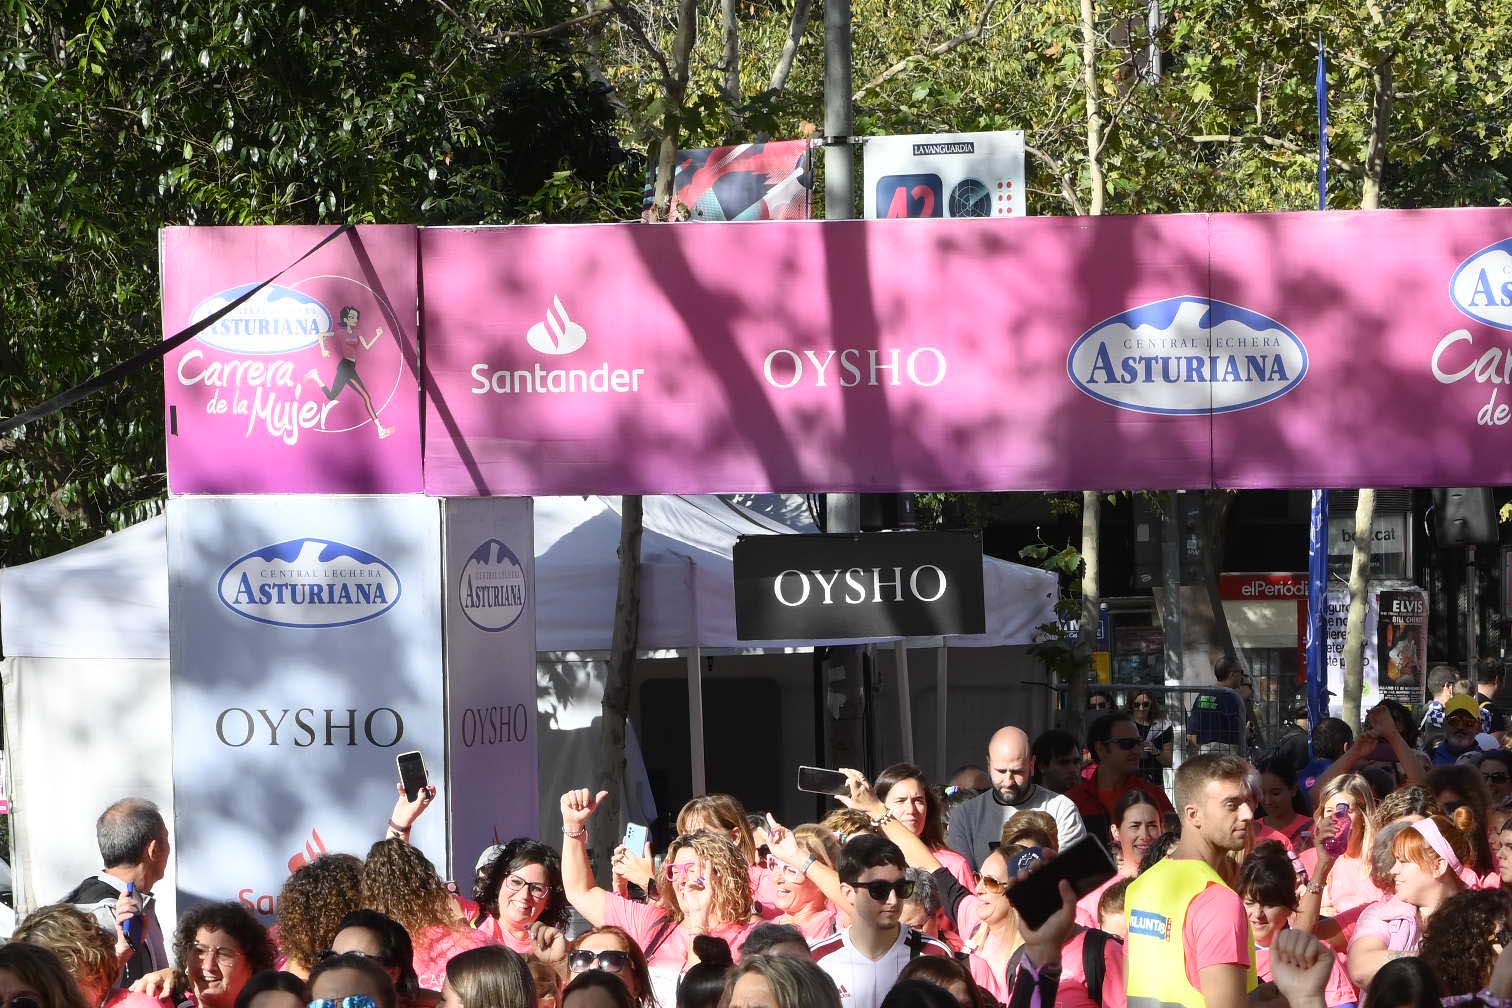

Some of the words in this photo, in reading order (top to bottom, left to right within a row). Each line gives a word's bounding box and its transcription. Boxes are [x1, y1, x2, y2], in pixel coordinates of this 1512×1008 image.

[1086, 341, 1289, 384] ASTURIANA
[1123, 338, 1196, 350] CENTRAL
[1204, 336, 1281, 349] LECHERA
[177, 350, 295, 389] Carrera
[470, 361, 645, 394] Santander
[763, 346, 947, 390] OYSHO
[206, 390, 228, 414] de
[233, 387, 248, 414] la
[247, 384, 340, 446] Mujer
[1477, 387, 1512, 426] de
[233, 571, 388, 606] ASTURIANA
[260, 569, 319, 579] CENTRAL
[324, 568, 383, 578] LECHERA
[464, 573, 523, 609] ASTURIANA
[773, 565, 947, 607] OYSHO
[1392, 599, 1424, 613] ELVIS
[215, 707, 404, 749] OYSHO
[462, 703, 528, 748] OYSHO
